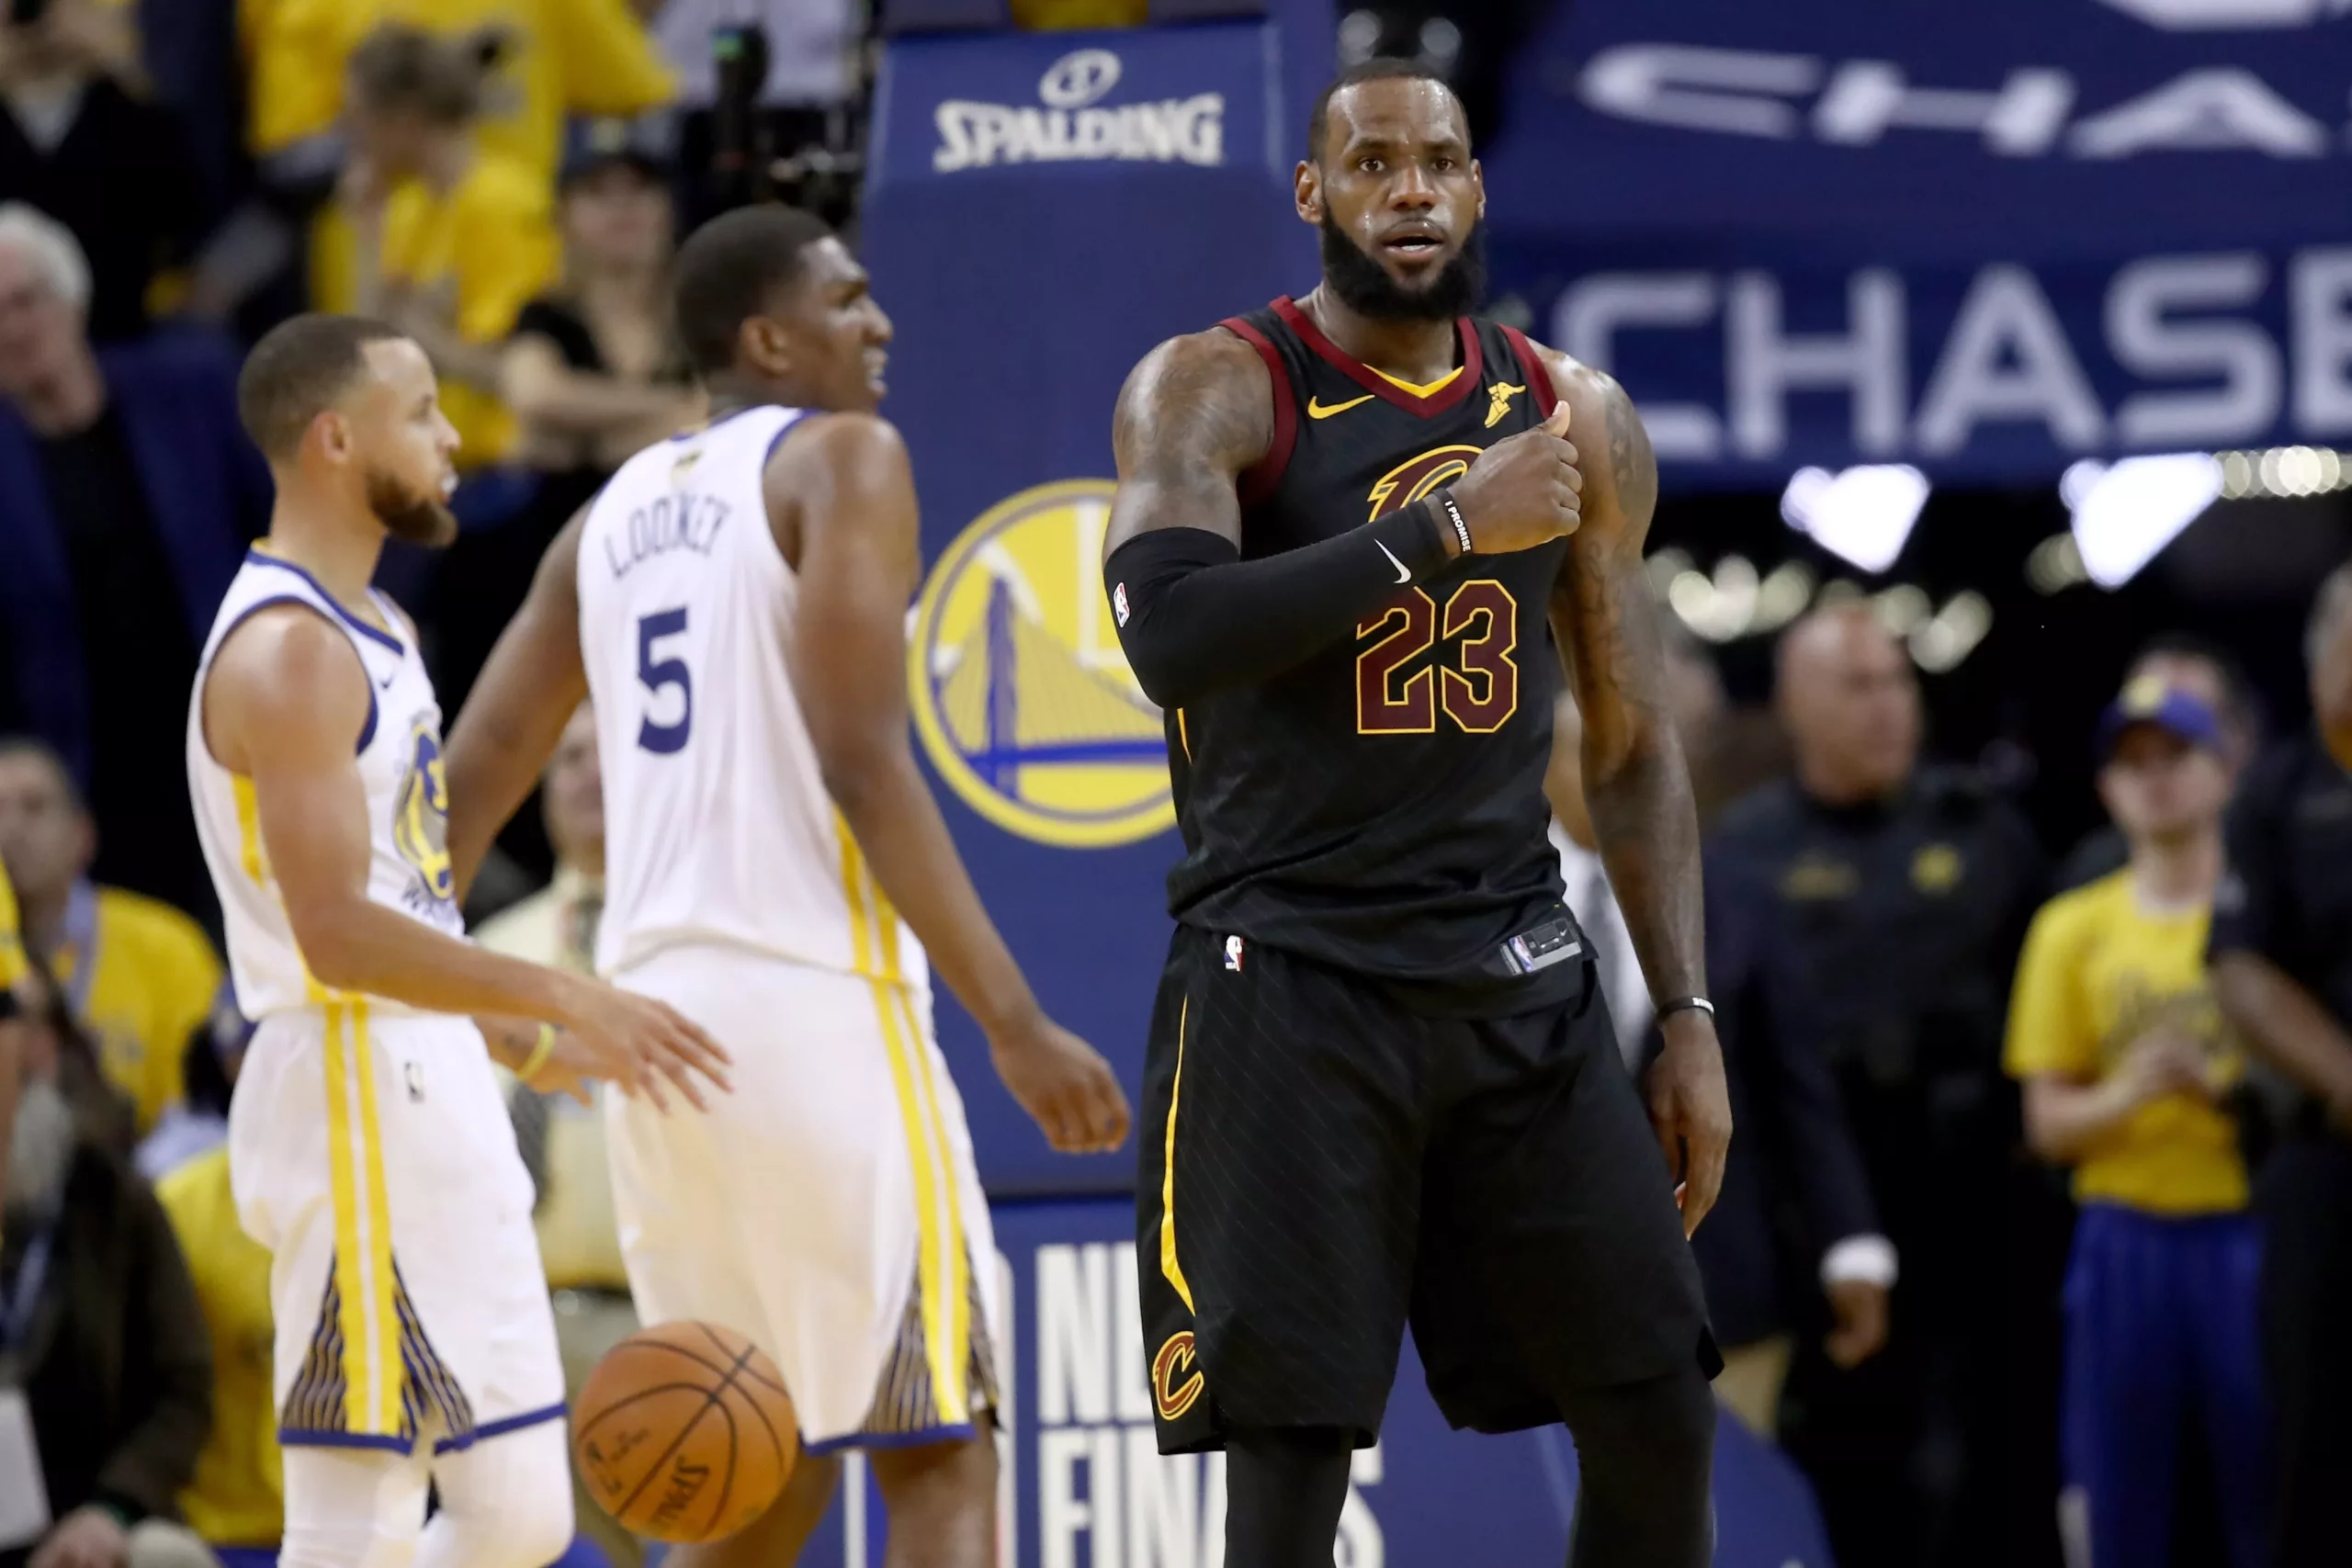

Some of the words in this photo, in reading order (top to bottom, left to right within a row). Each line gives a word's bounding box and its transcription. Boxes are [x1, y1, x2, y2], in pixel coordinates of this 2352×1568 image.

[933, 92, 1223, 172] SPALDING
[1448, 506, 1471, 552] PROMISE
[638, 604, 692, 755] 5
[1357, 580, 1517, 734] 23
